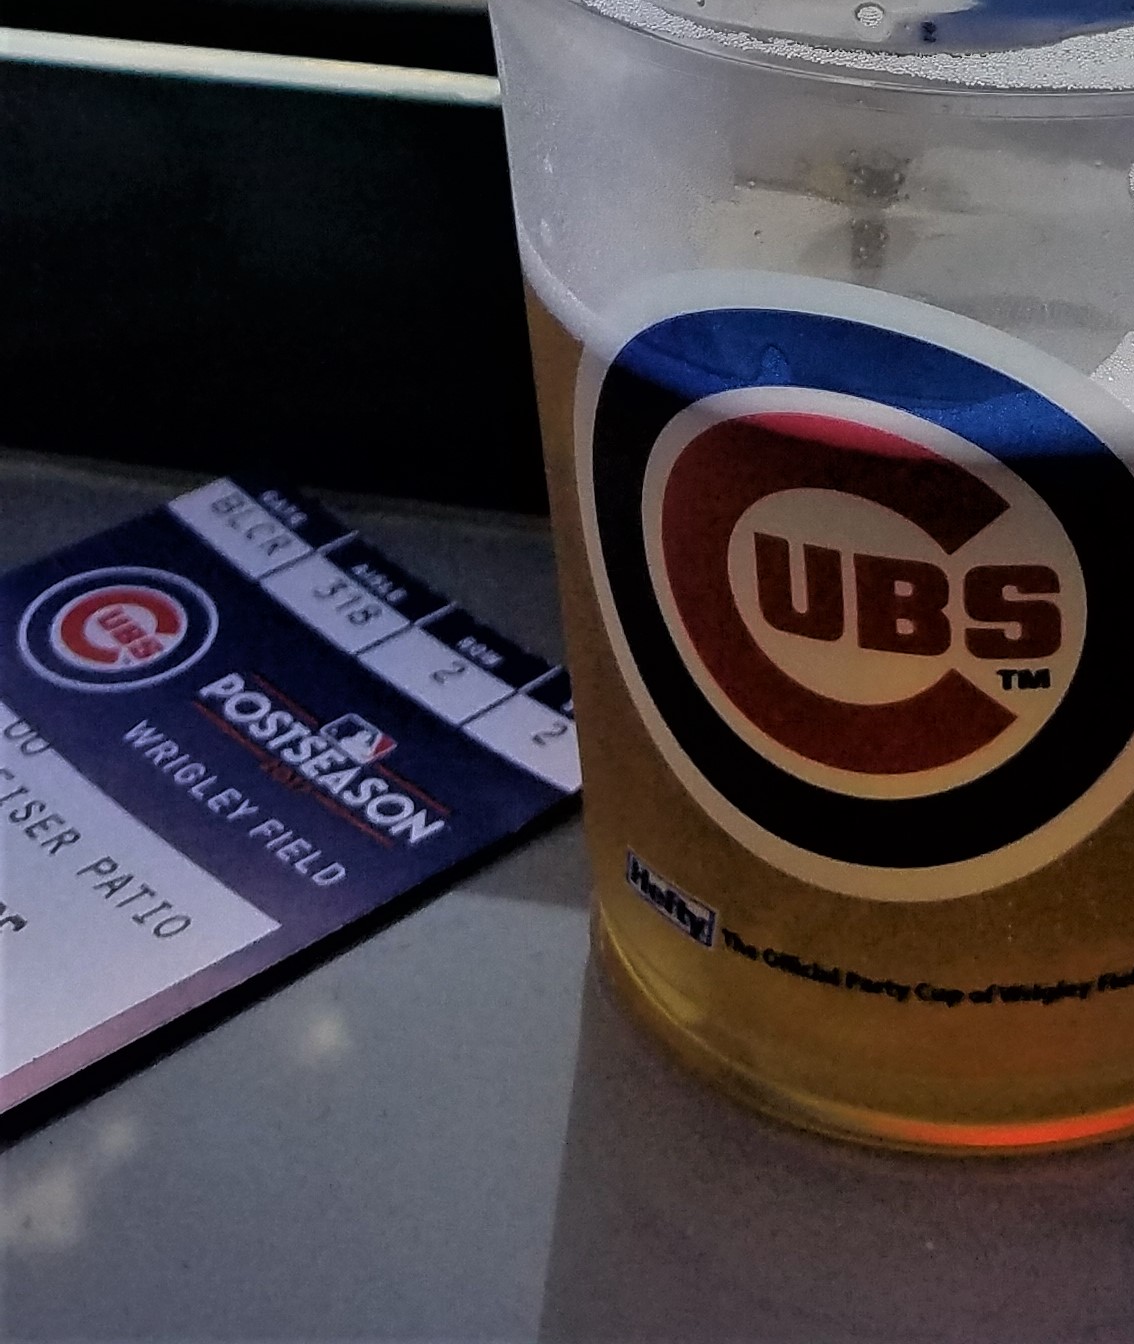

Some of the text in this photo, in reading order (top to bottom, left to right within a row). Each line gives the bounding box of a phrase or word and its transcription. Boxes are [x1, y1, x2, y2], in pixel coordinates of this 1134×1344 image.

[430, 660, 467, 685] 2
[532, 721, 568, 746] 2
[996, 668, 1052, 691] TM
[198, 672, 448, 846] POSTSEASON
[121, 718, 349, 888] WRIGLEY FIELD
[75, 855, 193, 940] PATIO
[628, 855, 709, 942] Hefty
[721, 927, 758, 962] The
[844, 970, 911, 1003] Party
[914, 982, 966, 1008] Cup
[967, 983, 997, 1004] of
